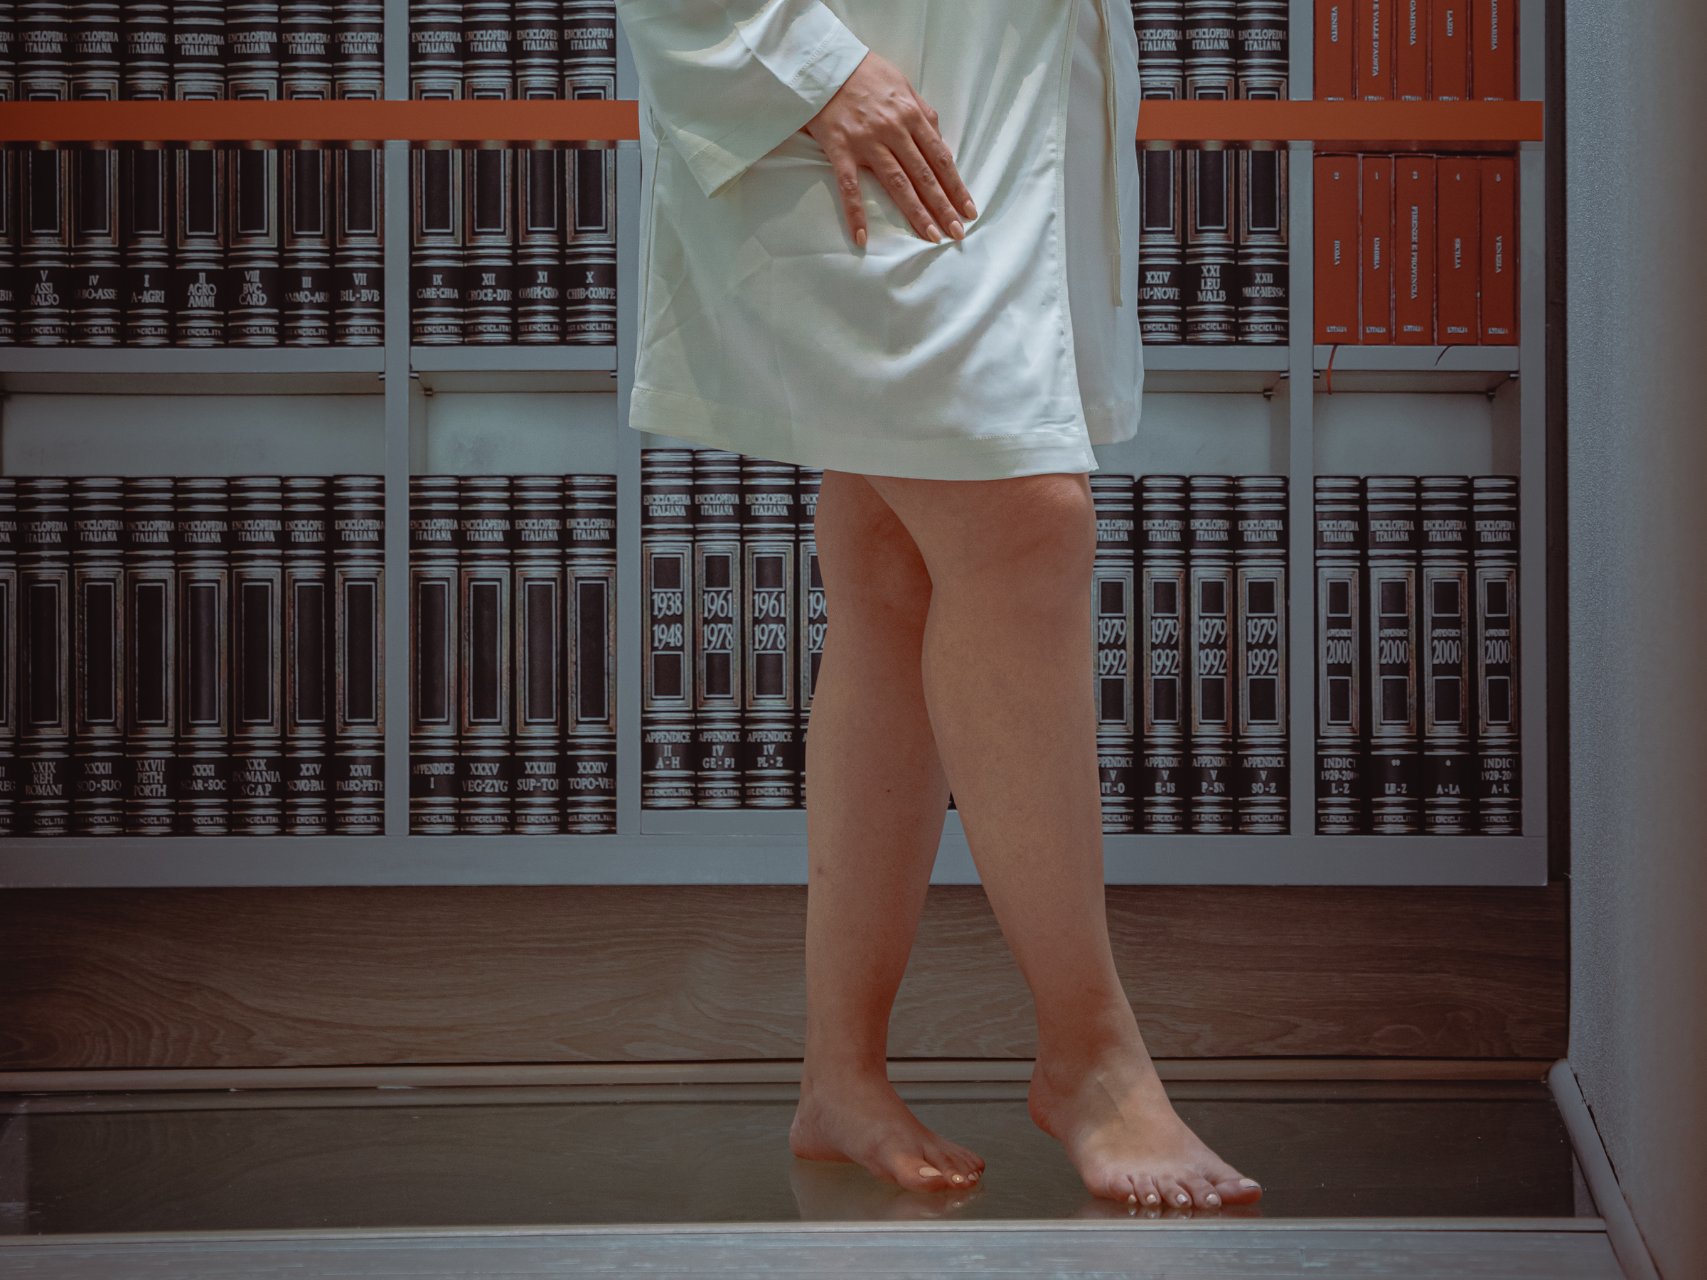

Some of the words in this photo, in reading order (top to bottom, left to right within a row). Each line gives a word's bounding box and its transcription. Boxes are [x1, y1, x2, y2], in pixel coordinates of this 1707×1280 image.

[412, 32, 461, 42] ENCICLOPEDIA
[565, 28, 613, 39] ENCICLOPEDIA
[1186, 29, 1235, 39] ENCICLOPEDIA
[25, 43, 61, 53] ITALIANA
[129, 44, 164, 54] ITALIANA
[182, 44, 218, 55] ITALIANA
[234, 43, 270, 54] ITALIANA
[289, 44, 325, 54] ITALIANA
[341, 43, 378, 54] ITALIANA
[418, 42, 455, 53] ITALIANA
[471, 42, 507, 52] ITALIANA
[571, 40, 607, 50] ITALIANA
[1192, 39, 1229, 50] ITALIANA
[1245, 41, 1281, 51] ITALIANA
[41, 271, 48, 280] V
[1201, 266, 1219, 276] XXI
[302, 277, 312, 287] III
[353, 273, 366, 284] VII
[482, 274, 496, 285] XII
[537, 272, 548, 283] XI
[586, 272, 593, 282] X
[1145, 272, 1170, 283] XXIV
[1255, 272, 1273, 283] XXII
[1201, 278, 1219, 289] LEU
[188, 283, 216, 296] AGRO
[239, 295, 267, 305] CARD
[1197, 290, 1226, 302] MALB
[649, 505, 686, 516] ITALIANA
[700, 506, 733, 516] ITALIANA
[751, 505, 788, 516] ITALIANA
[81, 532, 117, 542] ITALIANA
[132, 533, 168, 542] ITALIANA
[185, 532, 221, 542] ITALIANA
[239, 532, 274, 542] ITALIANA
[342, 531, 378, 541] ITALIANA
[416, 531, 452, 541] ITALIANA
[467, 531, 504, 541] ITALIANA
[522, 531, 558, 541] ITALIANA
[573, 530, 610, 540] ITALIANA
[1149, 532, 1181, 542] ITALIANA
[1196, 531, 1228, 541] ITALIANA
[1244, 531, 1277, 541] ITALIANA
[1324, 532, 1353, 542] ITALIANA
[1376, 532, 1409, 542] ITALIANA
[1429, 531, 1461, 541] ITALIANA
[1481, 532, 1510, 542] ITALIANA
[652, 592, 682, 616] 1938
[703, 592, 733, 618] 1961
[753, 592, 785, 618] 1961
[652, 624, 682, 649] 1948
[703, 624, 733, 649] 1978
[1098, 619, 1126, 644] 1979
[1152, 619, 1179, 644] 1979
[1199, 619, 1226, 644] 1979
[1247, 618, 1277, 644] 1979
[754, 624, 785, 650] 1978
[1327, 640, 1351, 664] 2000
[1381, 640, 1409, 664] 2000
[1433, 640, 1460, 664] 2000
[1486, 640, 1510, 664] 2000
[1099, 650, 1126, 674] 1992
[1152, 650, 1179, 674] 1992
[1200, 650, 1226, 674] 1992
[1248, 650, 1277, 674] 1992
[646, 732, 691, 743] APPENDICE
[699, 732, 740, 743] APPENDICE
[748, 732, 792, 743] APPENDICE
[664, 745, 672, 756] II
[712, 745, 724, 756] IV
[763, 744, 775, 755] IV
[85, 763, 111, 775] XXXII
[137, 760, 165, 771] XXVII
[192, 766, 214, 776] XXXI
[300, 764, 321, 776] XXV
[350, 765, 371, 777] XXVI
[470, 764, 499, 776] XXXV
[525, 762, 556, 774] XXXIII
[578, 762, 607, 773] XXXIV
[1110, 771, 1117, 780] V
[1162, 771, 1169, 781] V
[1210, 770, 1217, 780] V
[1260, 770, 1267, 780] V
